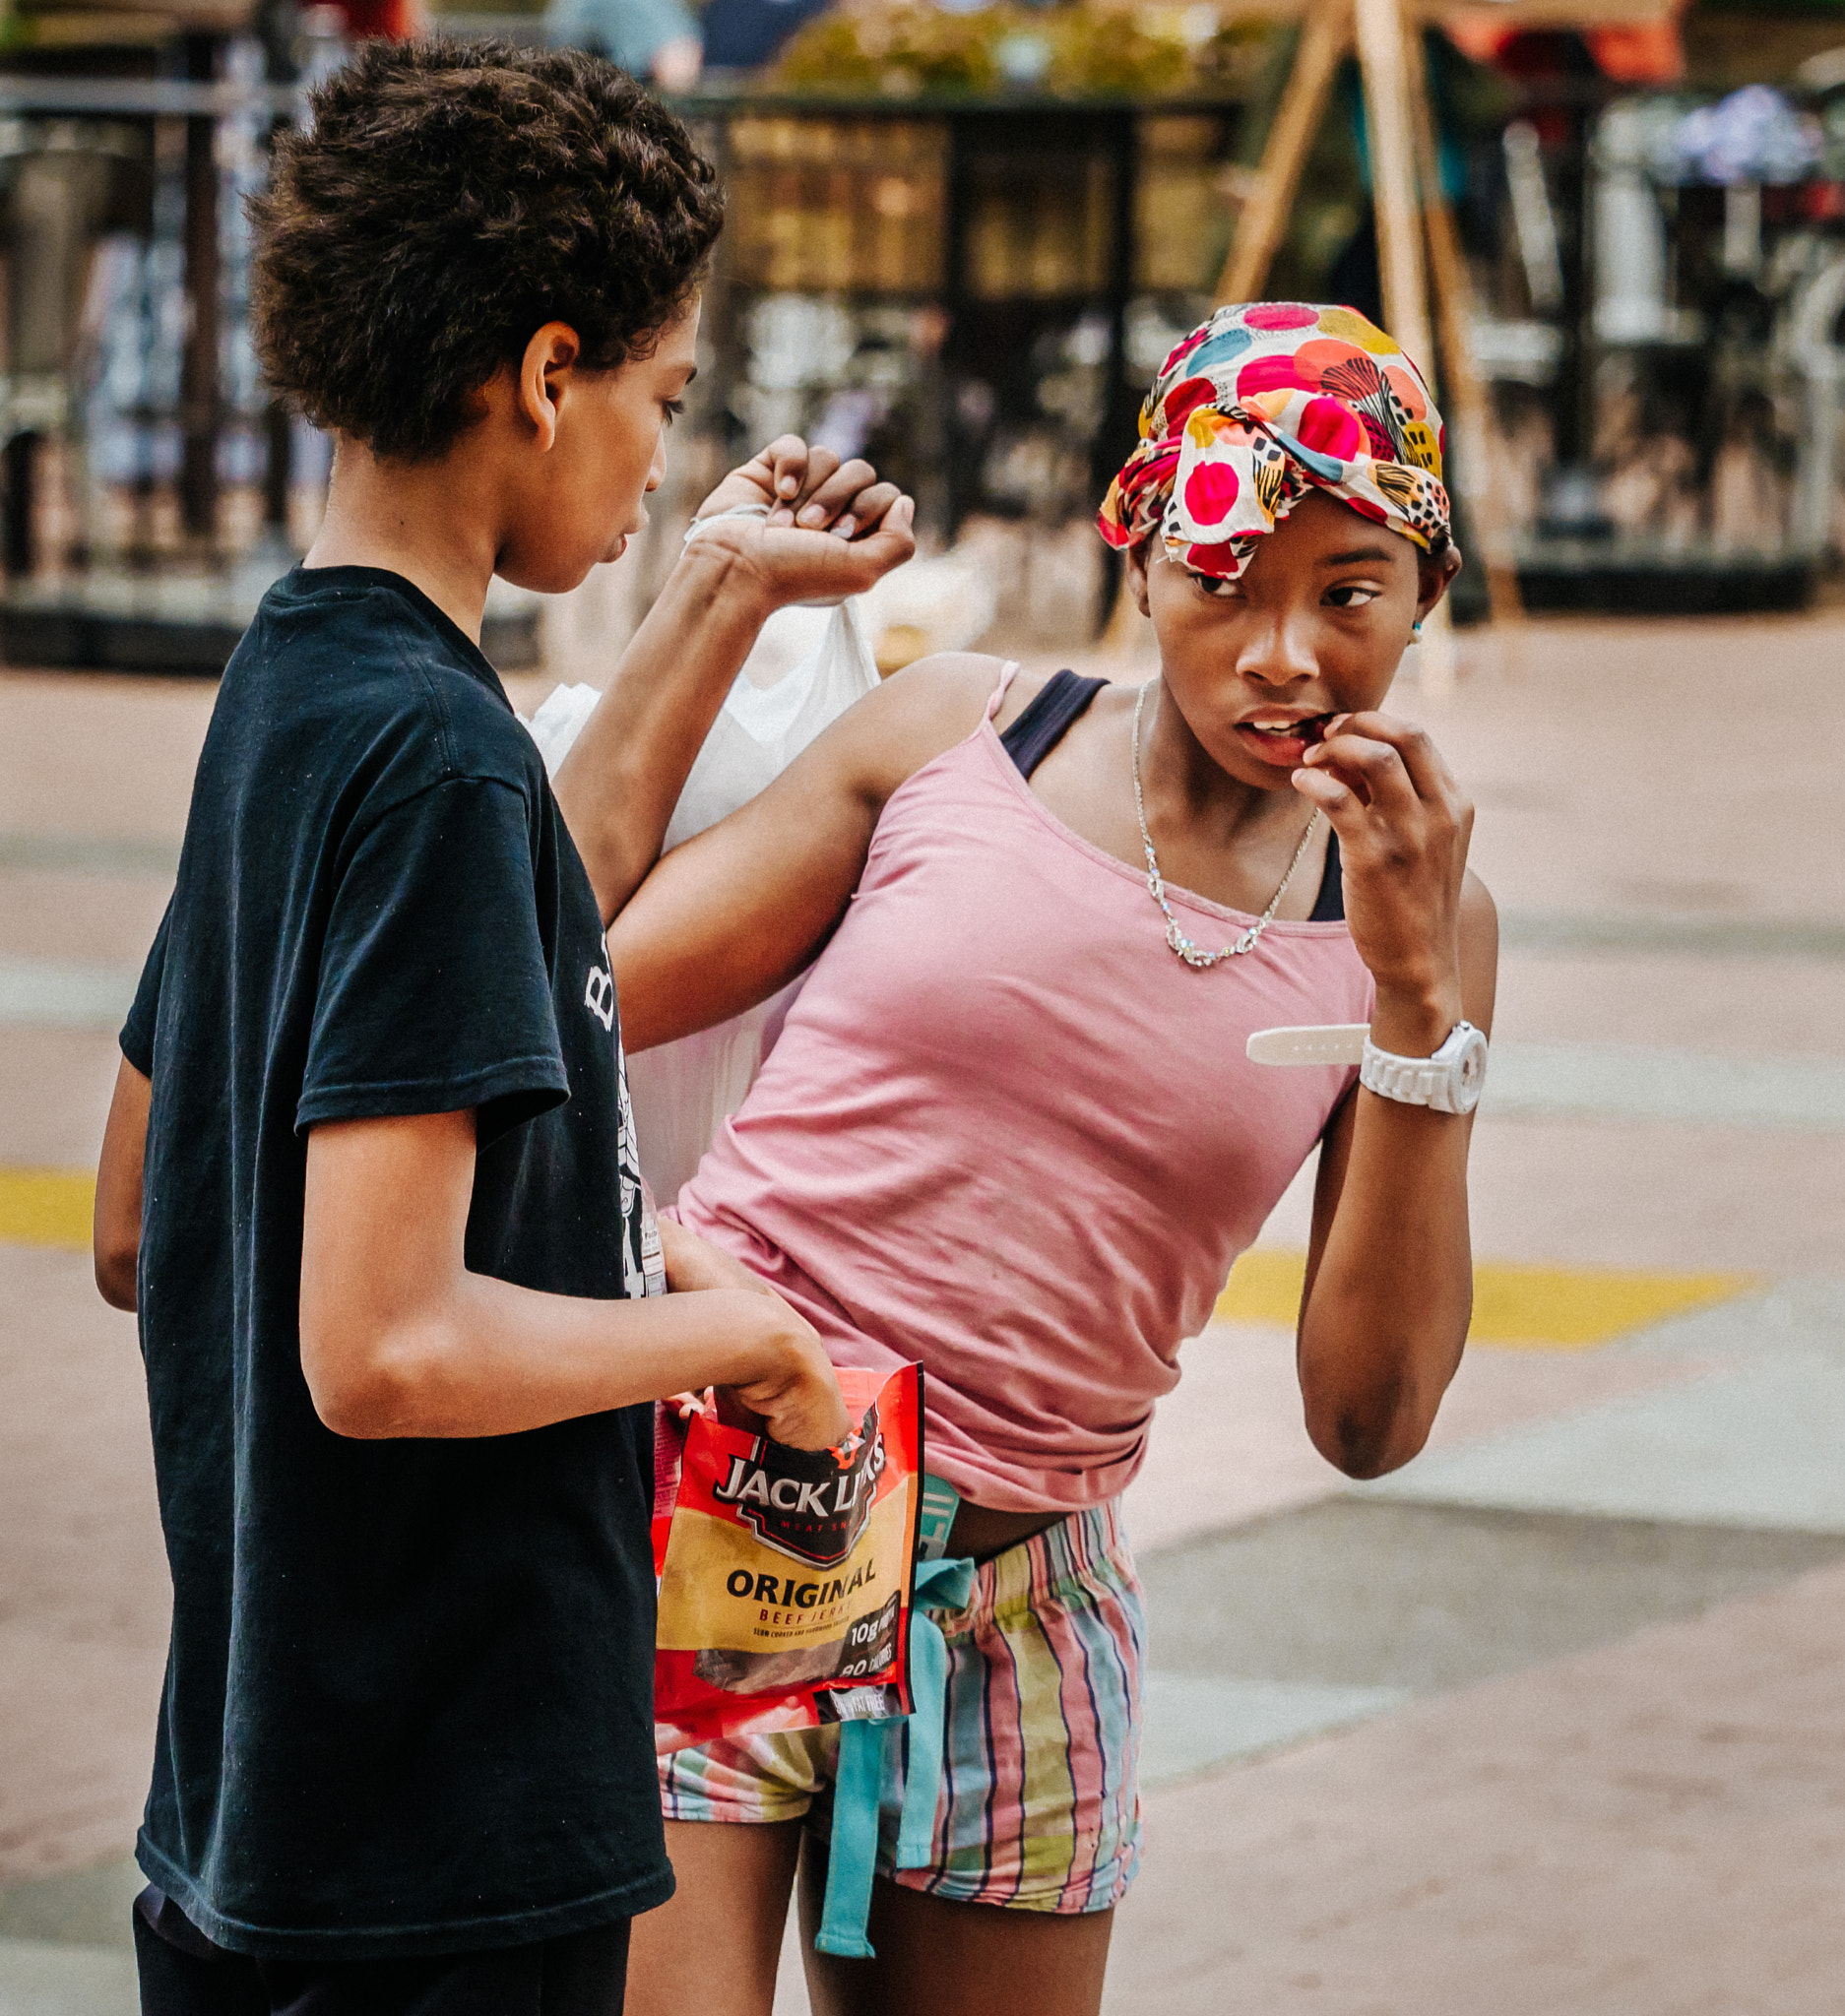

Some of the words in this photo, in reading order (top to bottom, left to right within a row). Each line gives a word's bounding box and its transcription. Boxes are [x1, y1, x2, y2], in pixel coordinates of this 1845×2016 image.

[584, 931, 614, 1032] B
[716, 1457, 830, 1518] JACK
[727, 1558, 876, 1608] ORIGINAL
[753, 1627, 770, 1638] SLOW
[759, 1608, 804, 1625] BEEF
[851, 1619, 879, 1647] 10g
